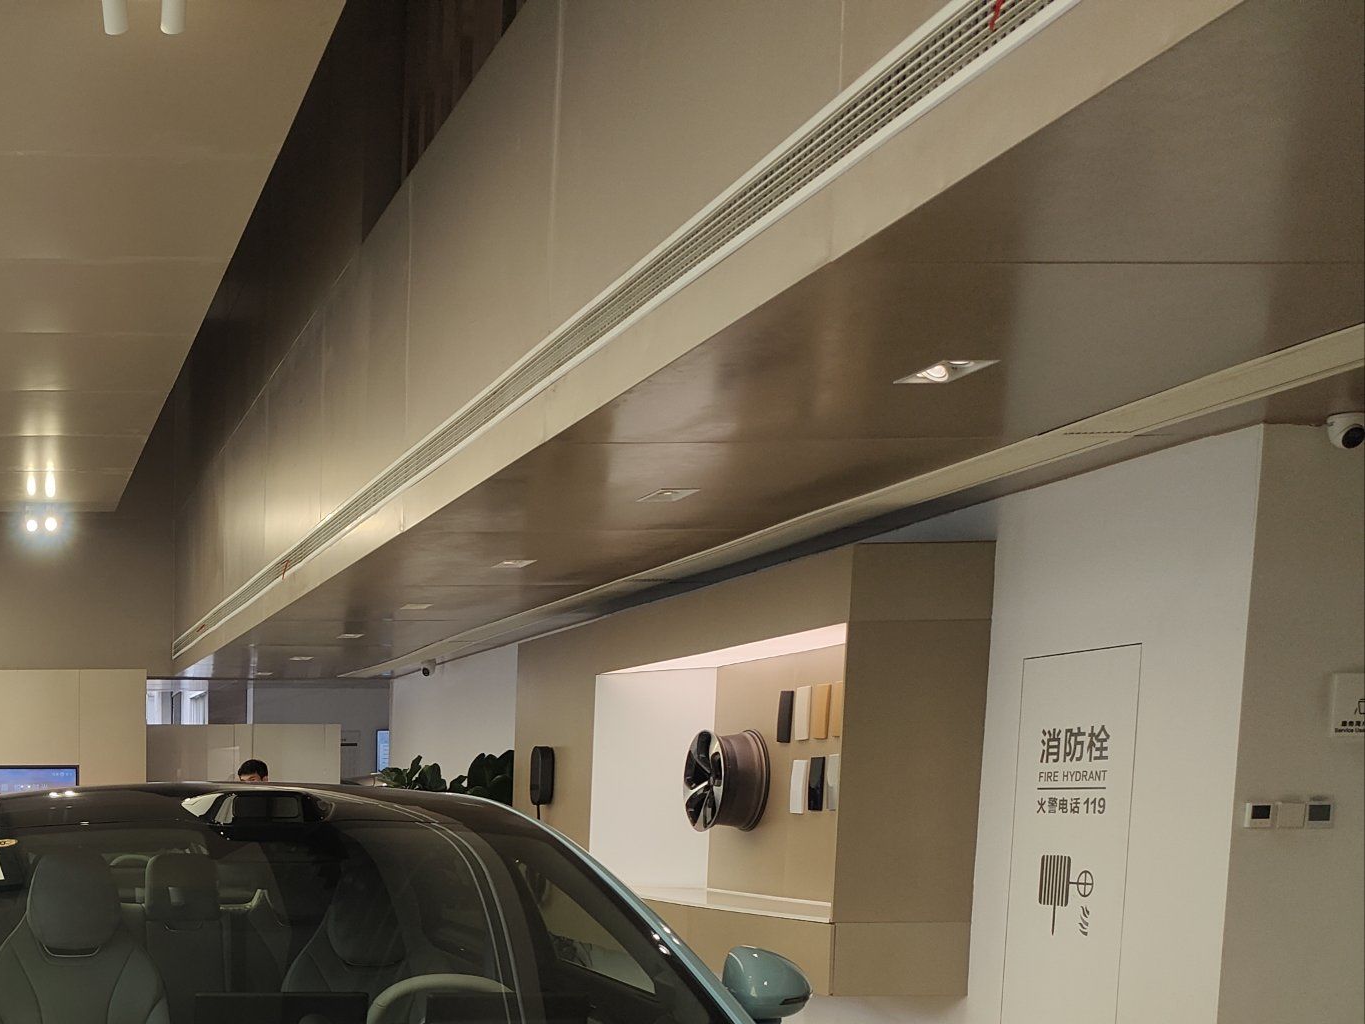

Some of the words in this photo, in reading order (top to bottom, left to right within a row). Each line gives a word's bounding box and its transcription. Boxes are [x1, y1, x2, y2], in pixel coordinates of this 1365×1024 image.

[1039, 724, 1111, 764] 消防栓
[1038, 770, 1059, 782] FIRE
[1062, 769, 1108, 782] HYDRANT
[1036, 797, 1081, 814] 火警电话
[1083, 797, 1106, 814] 119
